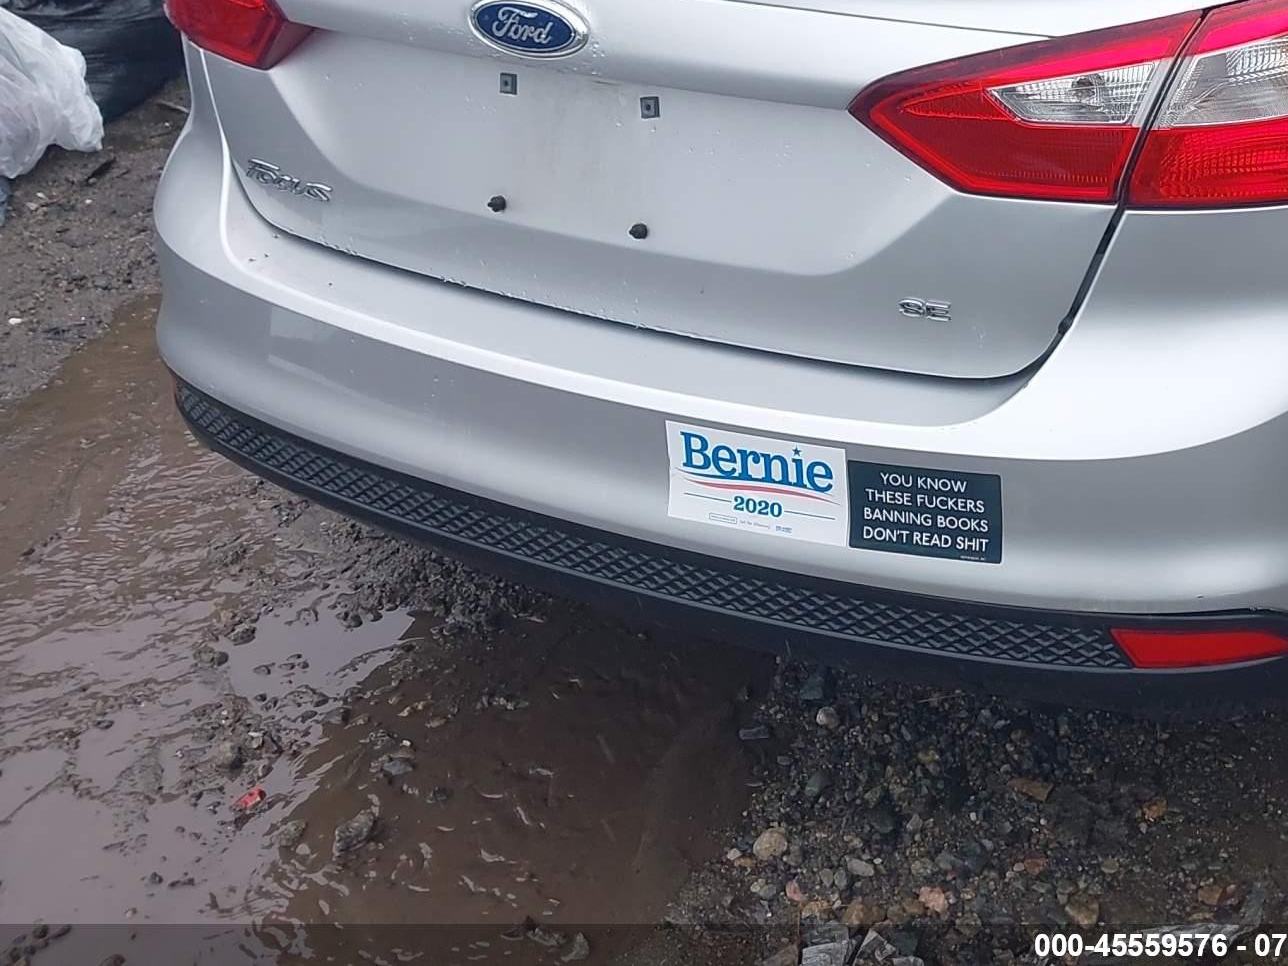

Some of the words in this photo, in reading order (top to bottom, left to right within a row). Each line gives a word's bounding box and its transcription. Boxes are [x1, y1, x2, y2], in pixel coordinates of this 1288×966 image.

[491, 5, 554, 47] Ford
[898, 297, 954, 323] SE
[680, 430, 834, 494] Bernie
[879, 472, 914, 488] YOU
[917, 476, 967, 493] KNOW
[733, 494, 783, 518] 2020
[865, 488, 913, 506] THESE
[916, 494, 986, 513] FUCKERS
[863, 507, 932, 527] BANNING
[936, 515, 989, 533] BOOKS
[862, 525, 910, 544] DON'T
[912, 531, 952, 548] READ
[955, 536, 989, 553] SHIT
